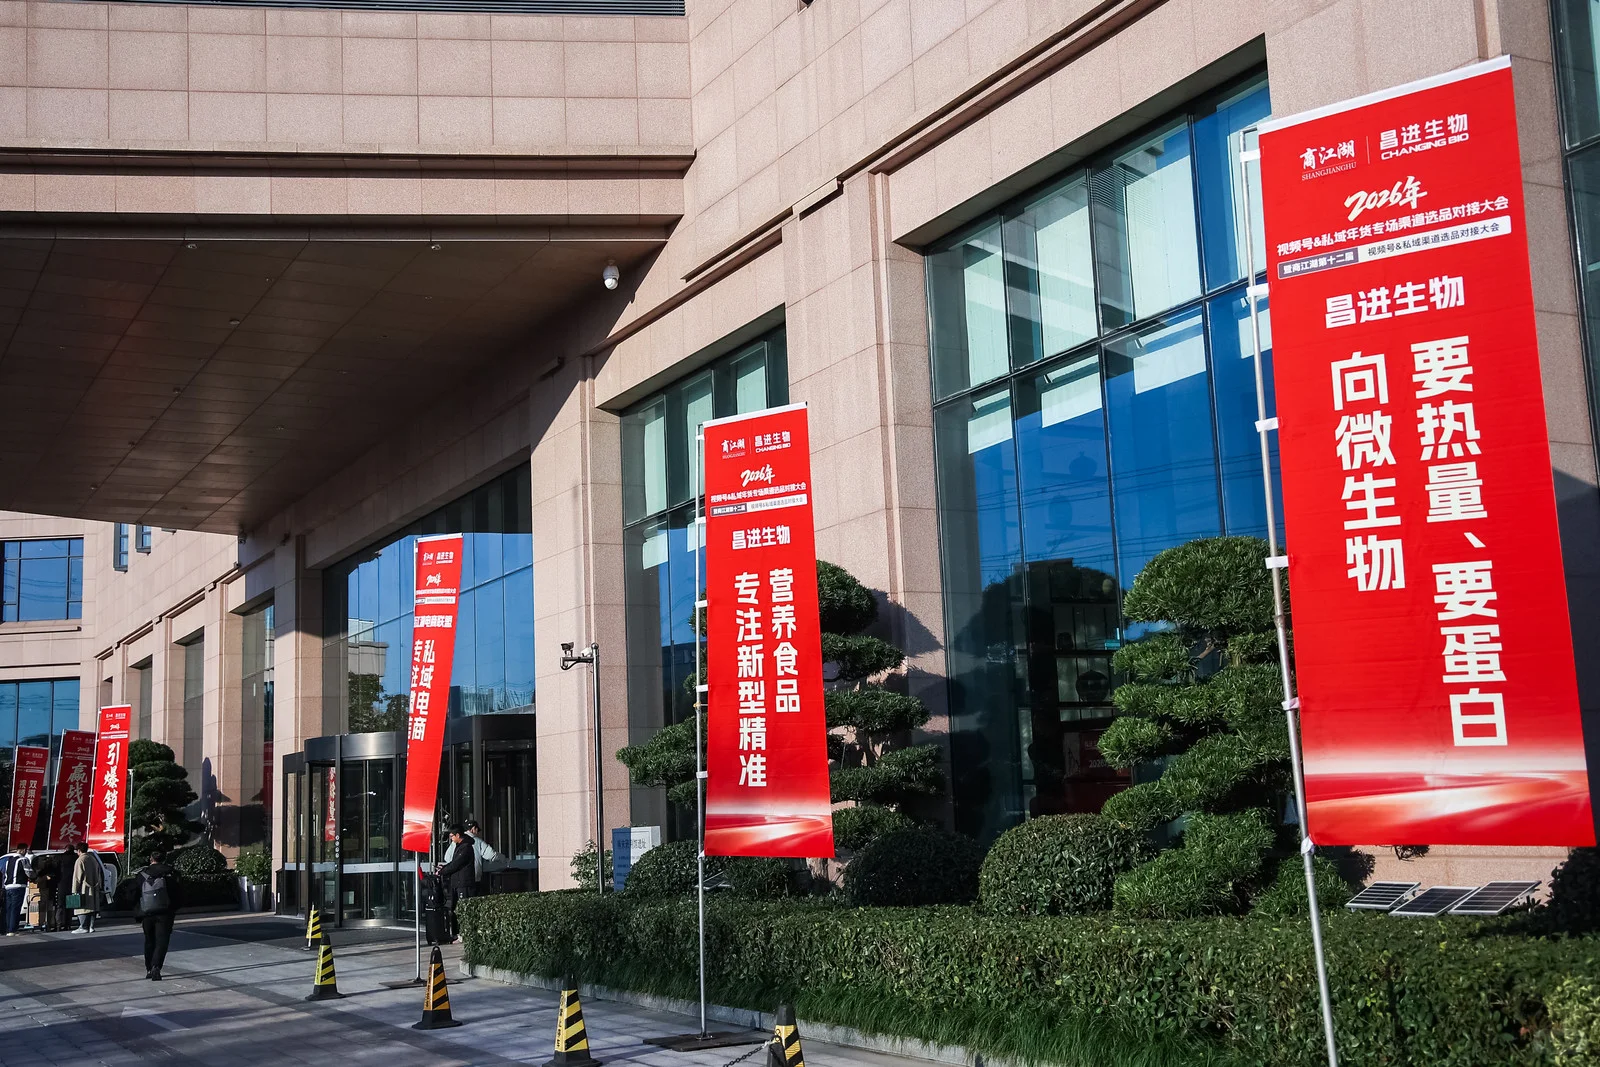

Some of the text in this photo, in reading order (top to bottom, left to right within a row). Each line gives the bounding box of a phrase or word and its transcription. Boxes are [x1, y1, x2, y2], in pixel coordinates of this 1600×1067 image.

[1299, 138, 1356, 170] 商江湖
[1379, 113, 1468, 151] 昌进生物
[1381, 132, 1470, 161] CHANGING BIO
[1301, 161, 1357, 181] SHANGJIANGHU
[1343, 175, 1428, 221] 2026年
[1276, 195, 1509, 257] 视频号&私域年货专场渠道选品对接大会
[1367, 222, 1500, 257] 视频号&私域渠道选品对接大会
[1325, 275, 1466, 329] 昌进生物
[754, 430, 791, 447] 昌进生物
[739, 463, 776, 487] 2026年
[1330, 350, 1406, 593] 向微生物
[731, 524, 791, 550] 昌进生物
[1410, 334, 1508, 748] 要热量、要蛋白
[768, 567, 801, 714] 营养食品
[411, 639, 436, 742] 私域电商
[734, 572, 768, 789] 专注新型精准
[102, 741, 120, 833] 引爆销量
